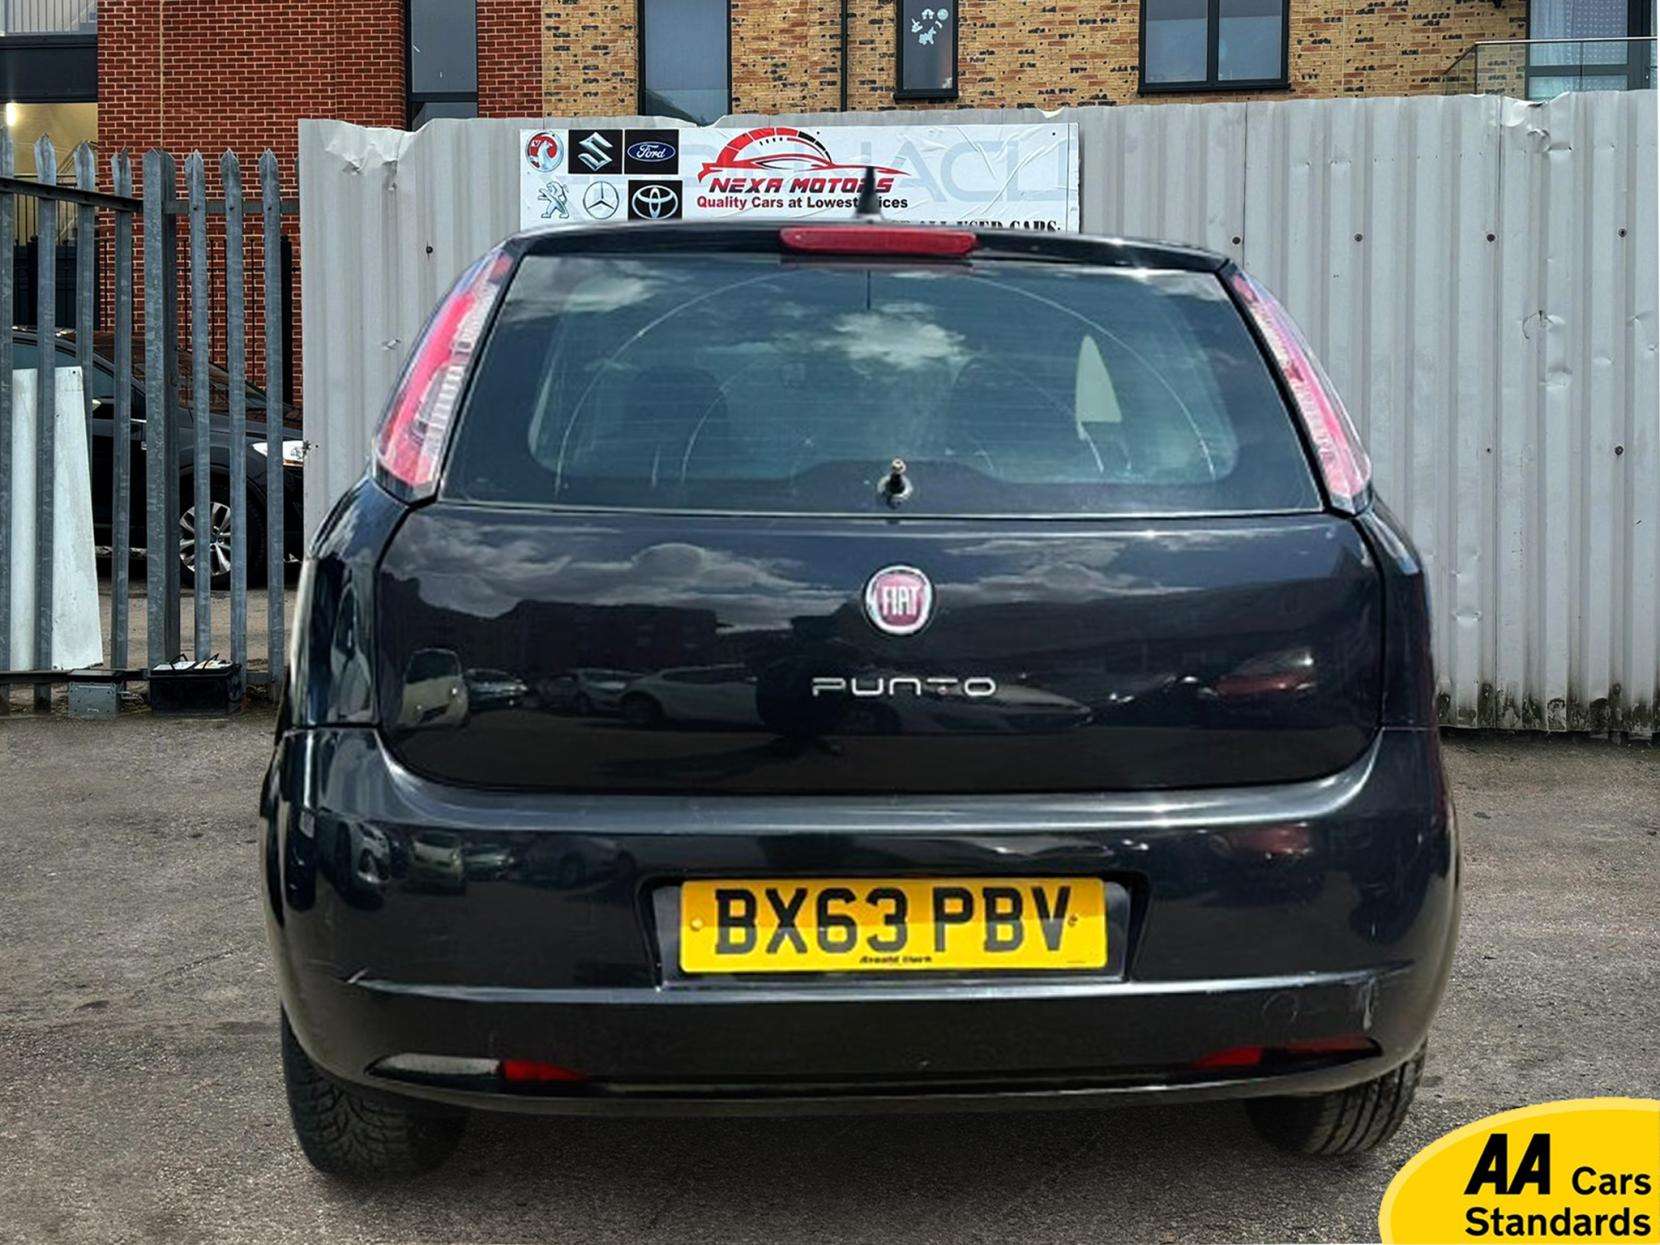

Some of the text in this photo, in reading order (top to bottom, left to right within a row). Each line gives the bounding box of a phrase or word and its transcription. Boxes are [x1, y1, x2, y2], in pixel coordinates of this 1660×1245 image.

[636, 144, 667, 159] Ford
[709, 178, 784, 193] NEXA
[697, 196, 748, 211] Quality
[752, 197, 784, 208] Cars
[788, 197, 803, 208] at
[807, 196, 859, 208] Lowest
[881, 586, 921, 615] FIAT
[812, 677, 996, 696] PUNTO
[714, 886, 1071, 955] BX63 PBV
